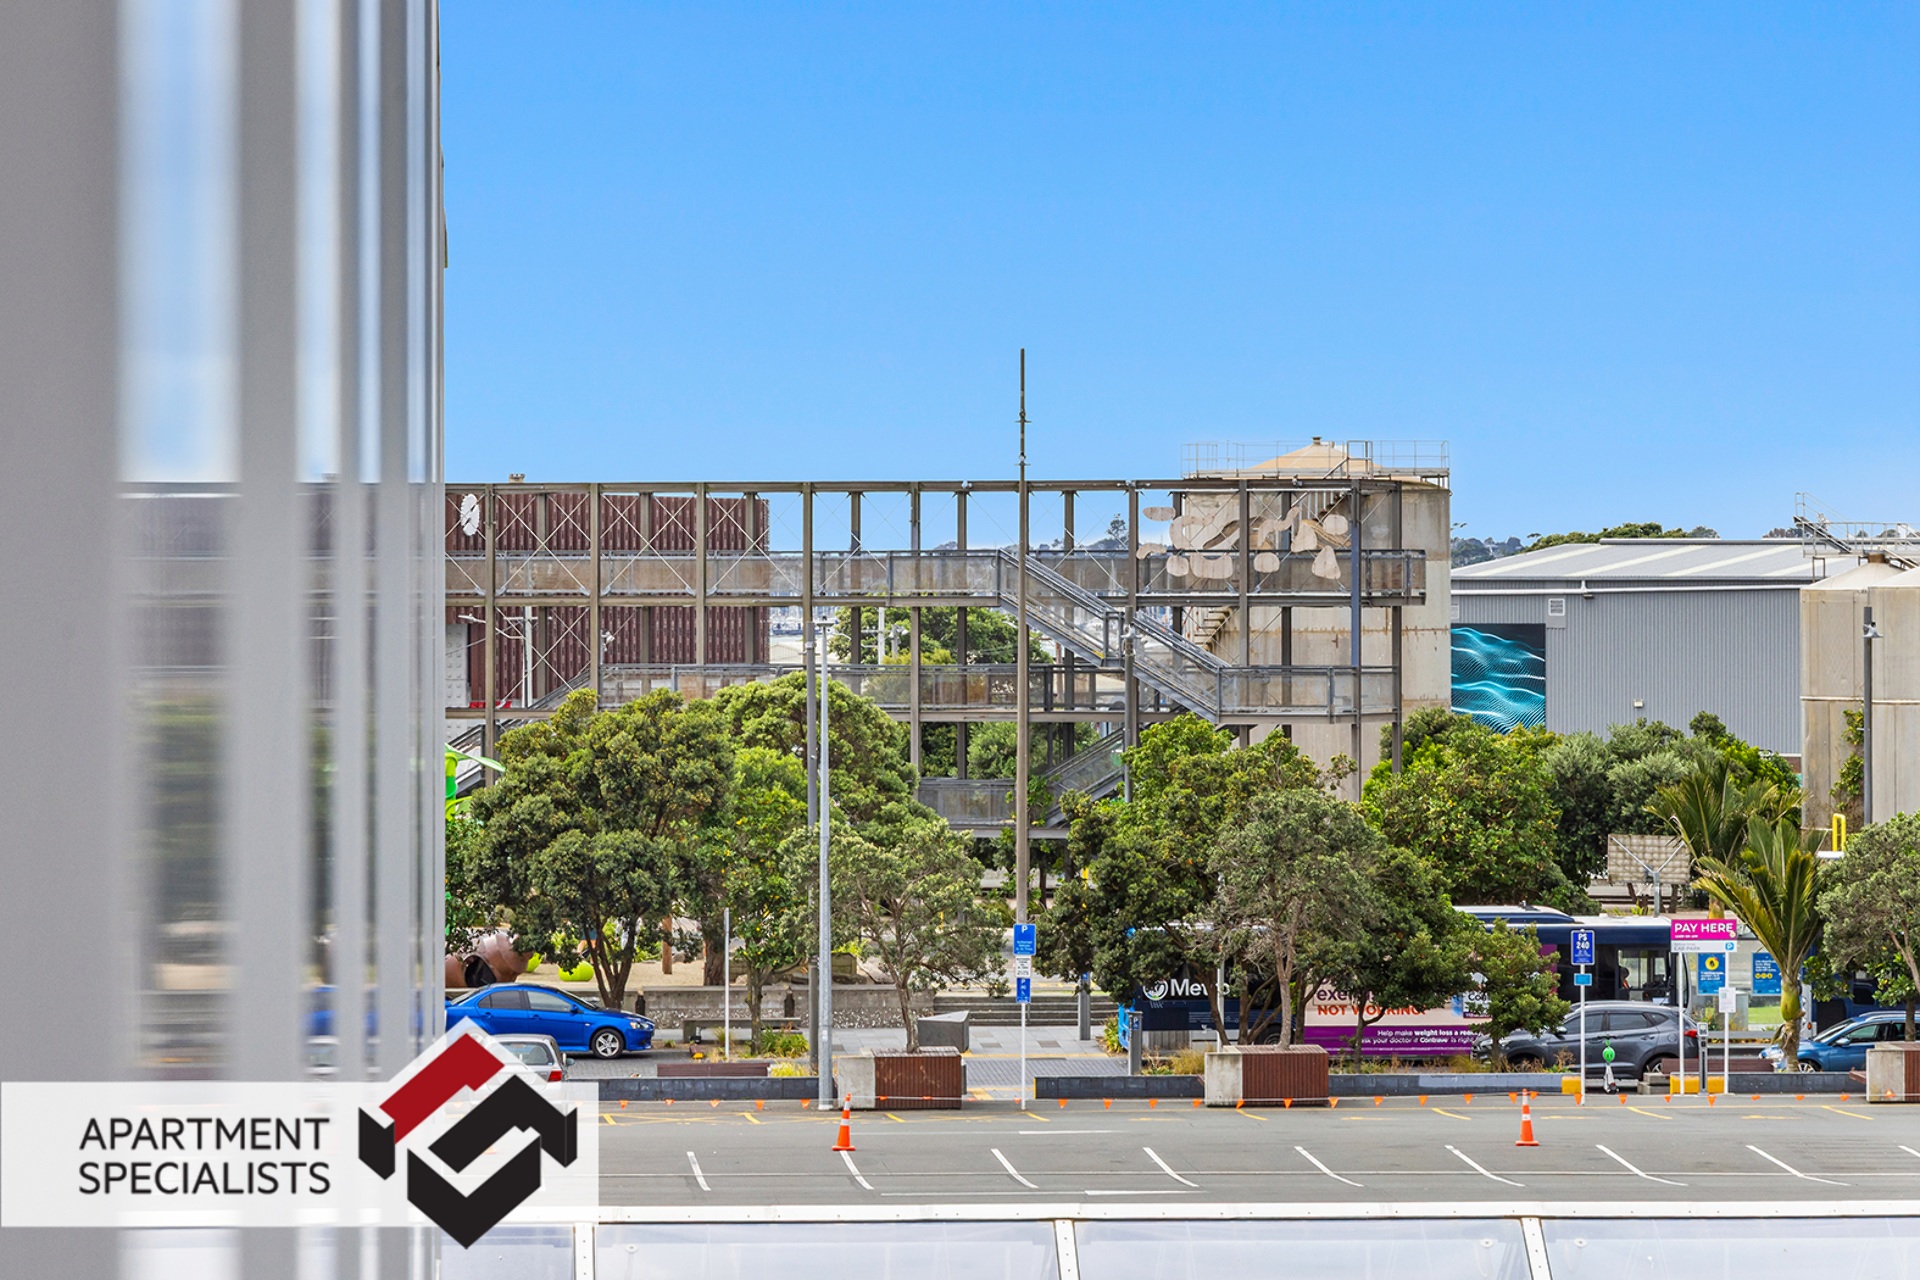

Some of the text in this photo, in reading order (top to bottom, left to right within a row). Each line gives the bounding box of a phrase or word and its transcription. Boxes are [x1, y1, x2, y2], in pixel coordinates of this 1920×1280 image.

[1674, 923, 1734, 933] PAY HERE
[1317, 1005, 1347, 1015] NOT
[1414, 1030, 1439, 1038] weight
